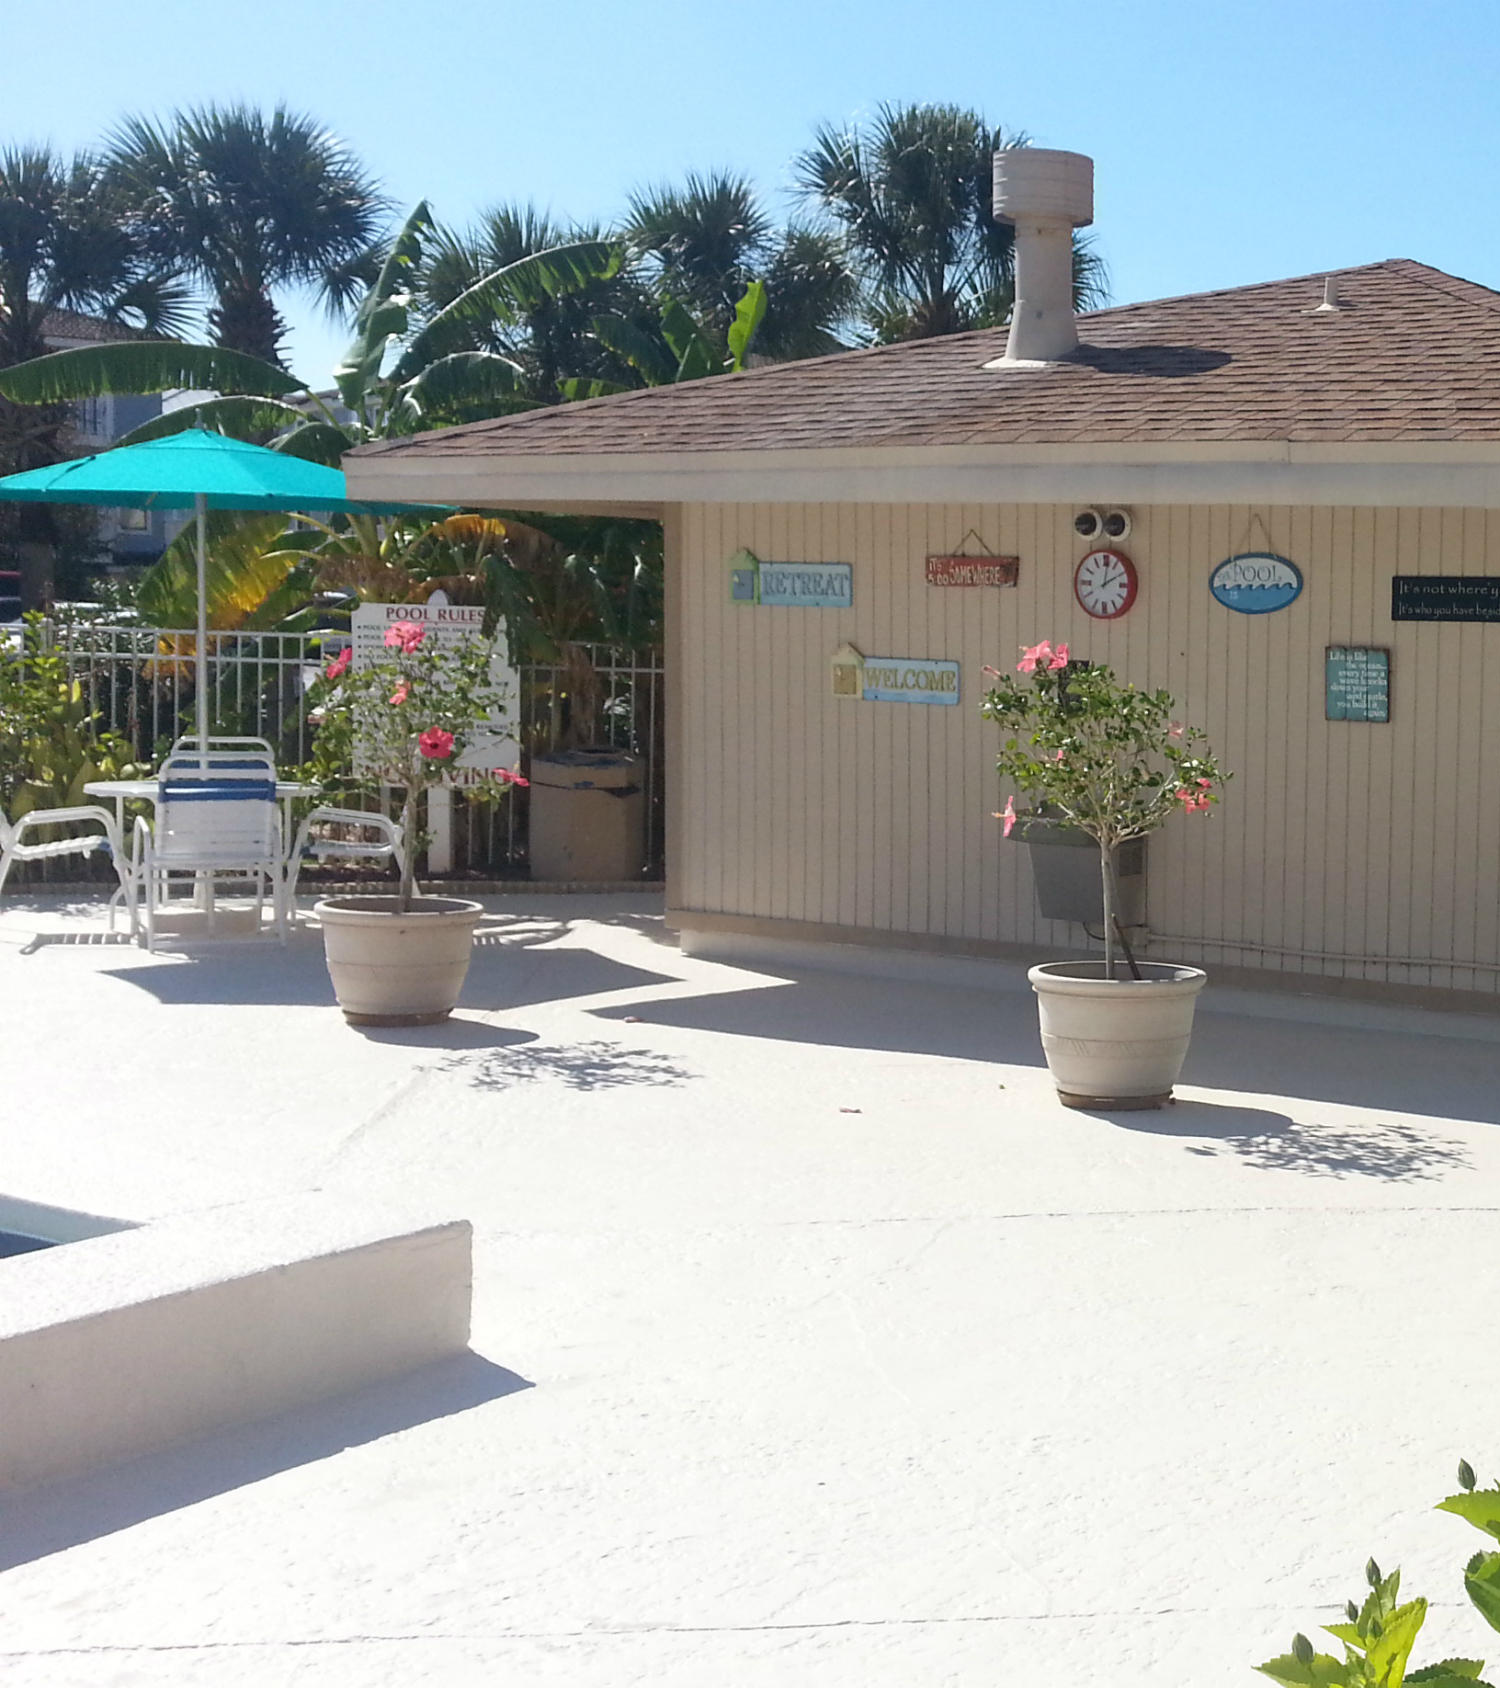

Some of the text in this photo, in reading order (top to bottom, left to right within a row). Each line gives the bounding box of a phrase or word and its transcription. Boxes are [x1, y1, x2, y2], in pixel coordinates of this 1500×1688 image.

[1233, 562, 1283, 582] POOL
[762, 571, 850, 597] RETREAT
[1399, 580, 1420, 594] It's
[1423, 584, 1444, 594] not
[1448, 581, 1487, 594] where
[385, 607, 485, 622] POOL RULES
[1414, 601, 1432, 614] who
[1433, 607, 1451, 619] you
[1452, 602, 1474, 615] have
[863, 667, 957, 692] WELCOME
